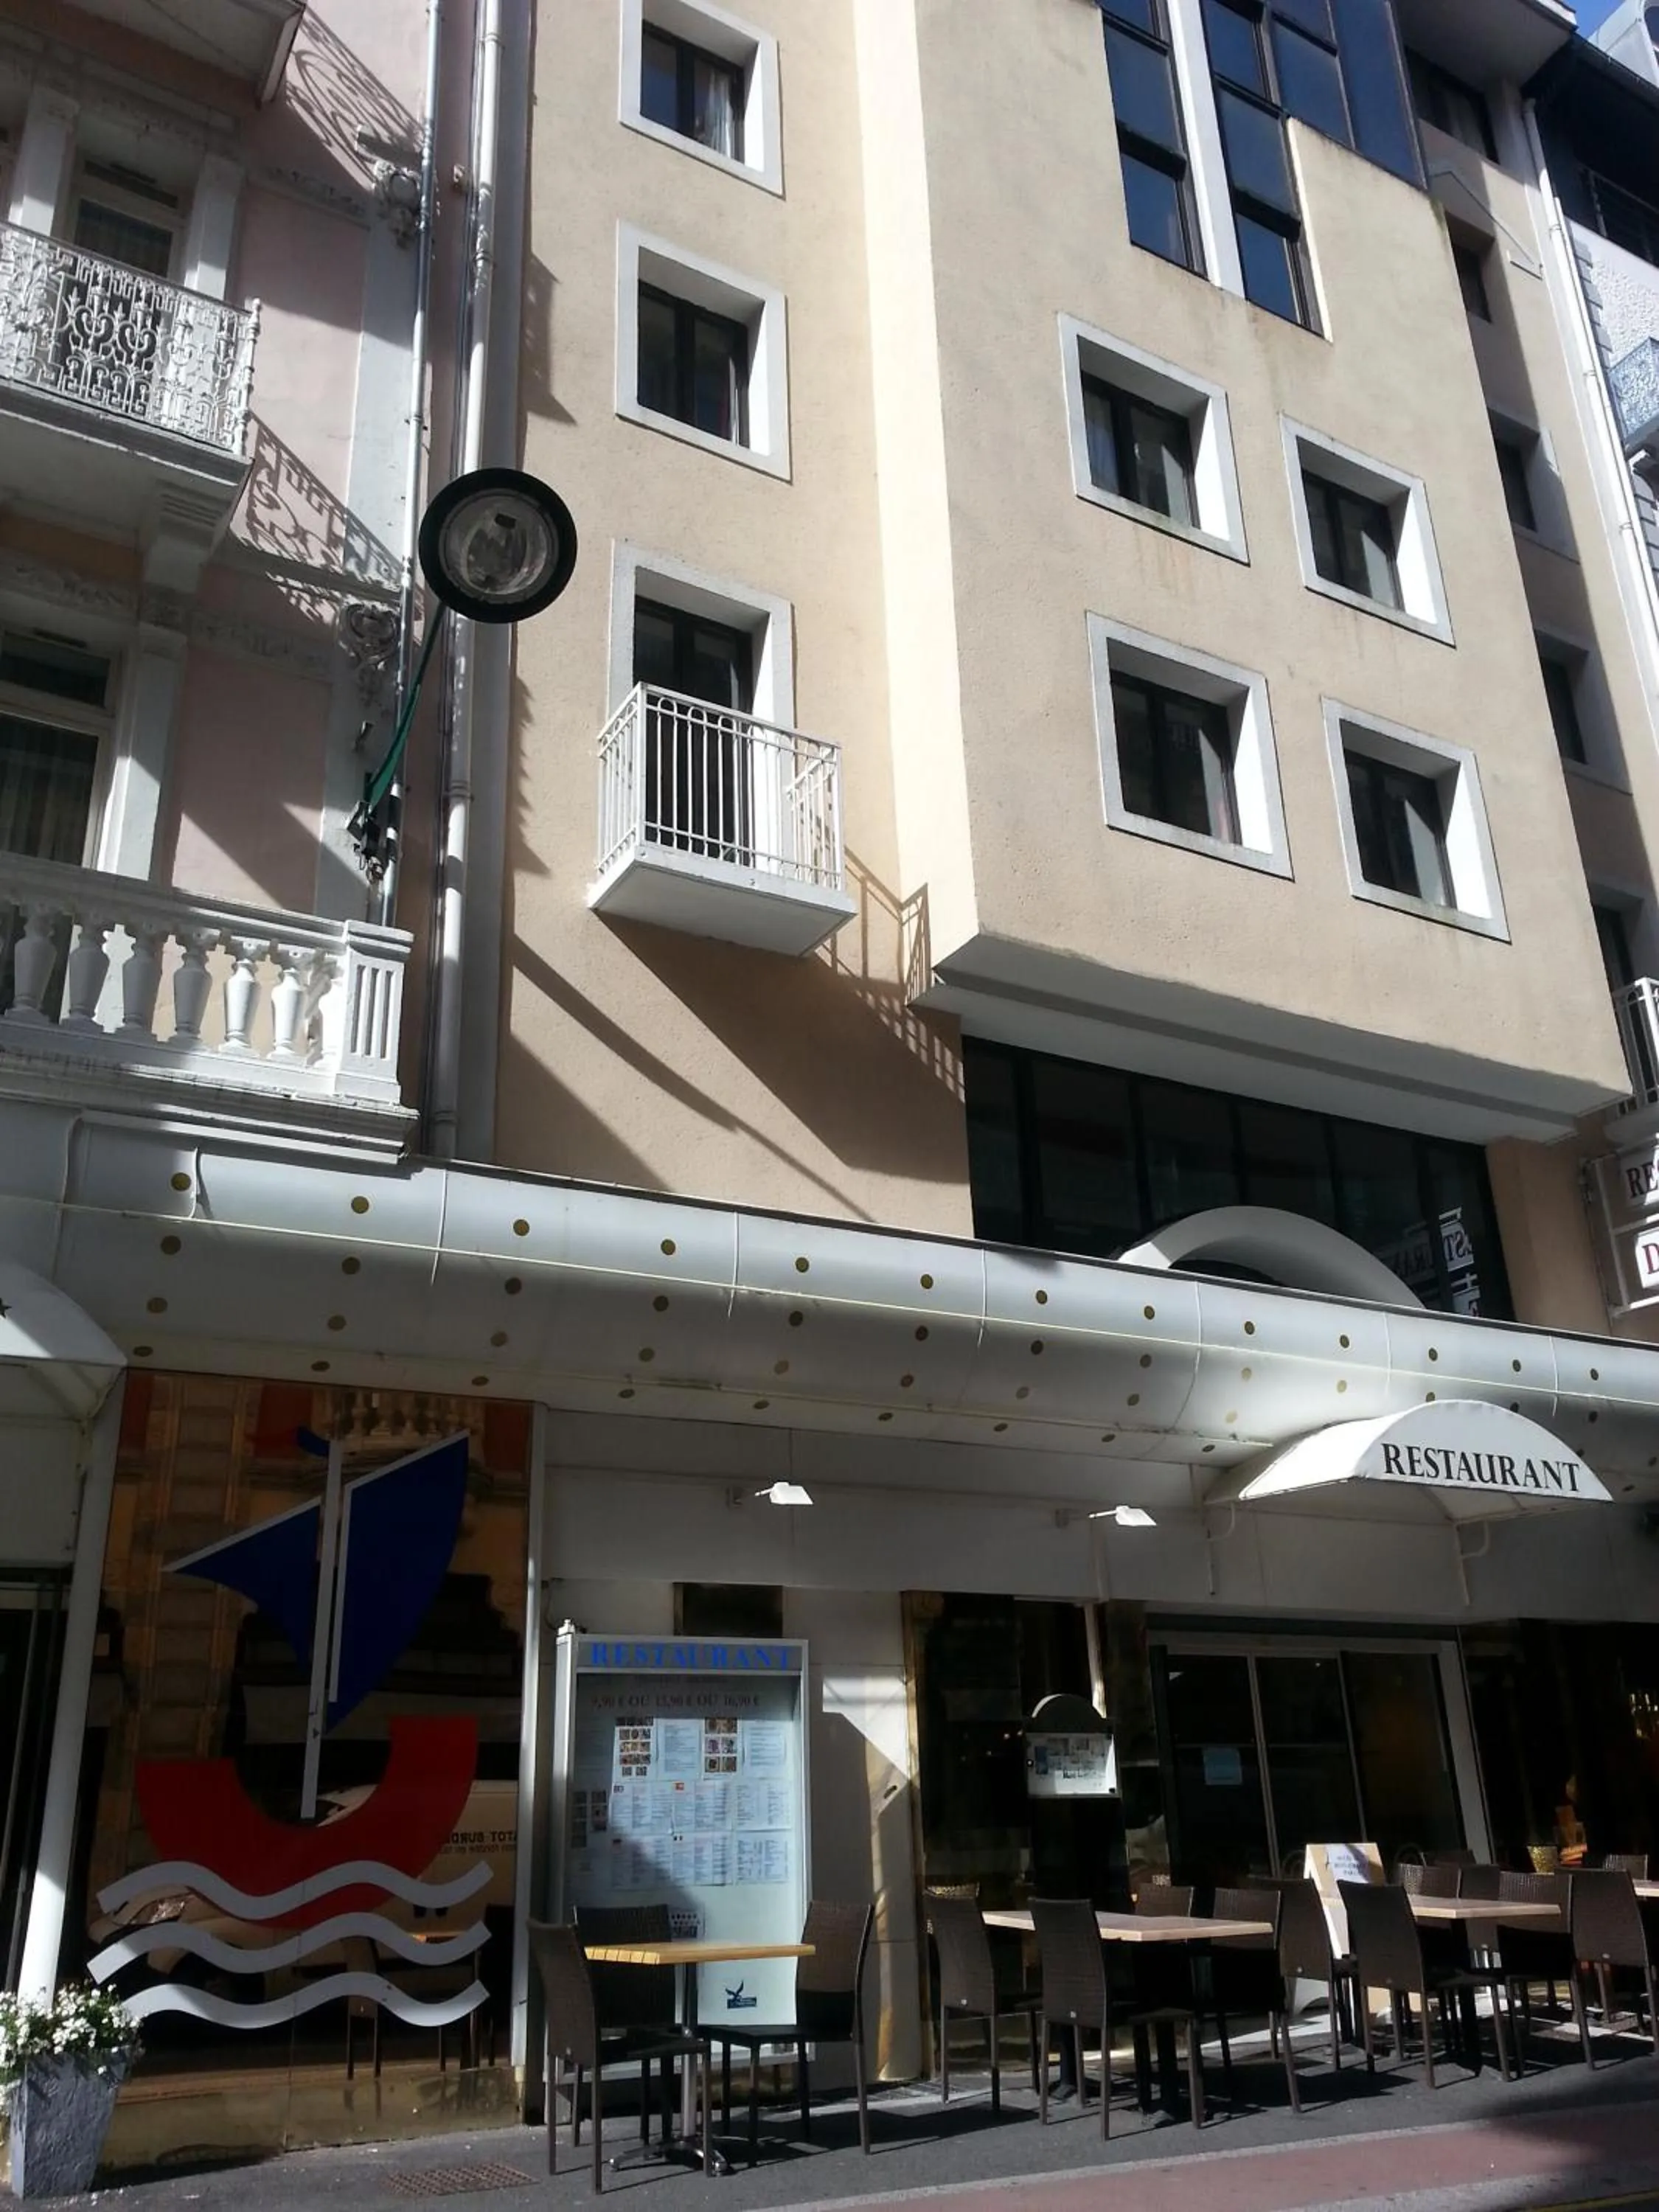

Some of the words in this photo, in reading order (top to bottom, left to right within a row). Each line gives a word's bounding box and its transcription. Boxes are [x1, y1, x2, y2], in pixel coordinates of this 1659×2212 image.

[1626, 1161, 1659, 1199] RE
[1381, 1443, 1581, 1492] RESTAURANT
[591, 1641, 791, 1669] RESTAURANT
